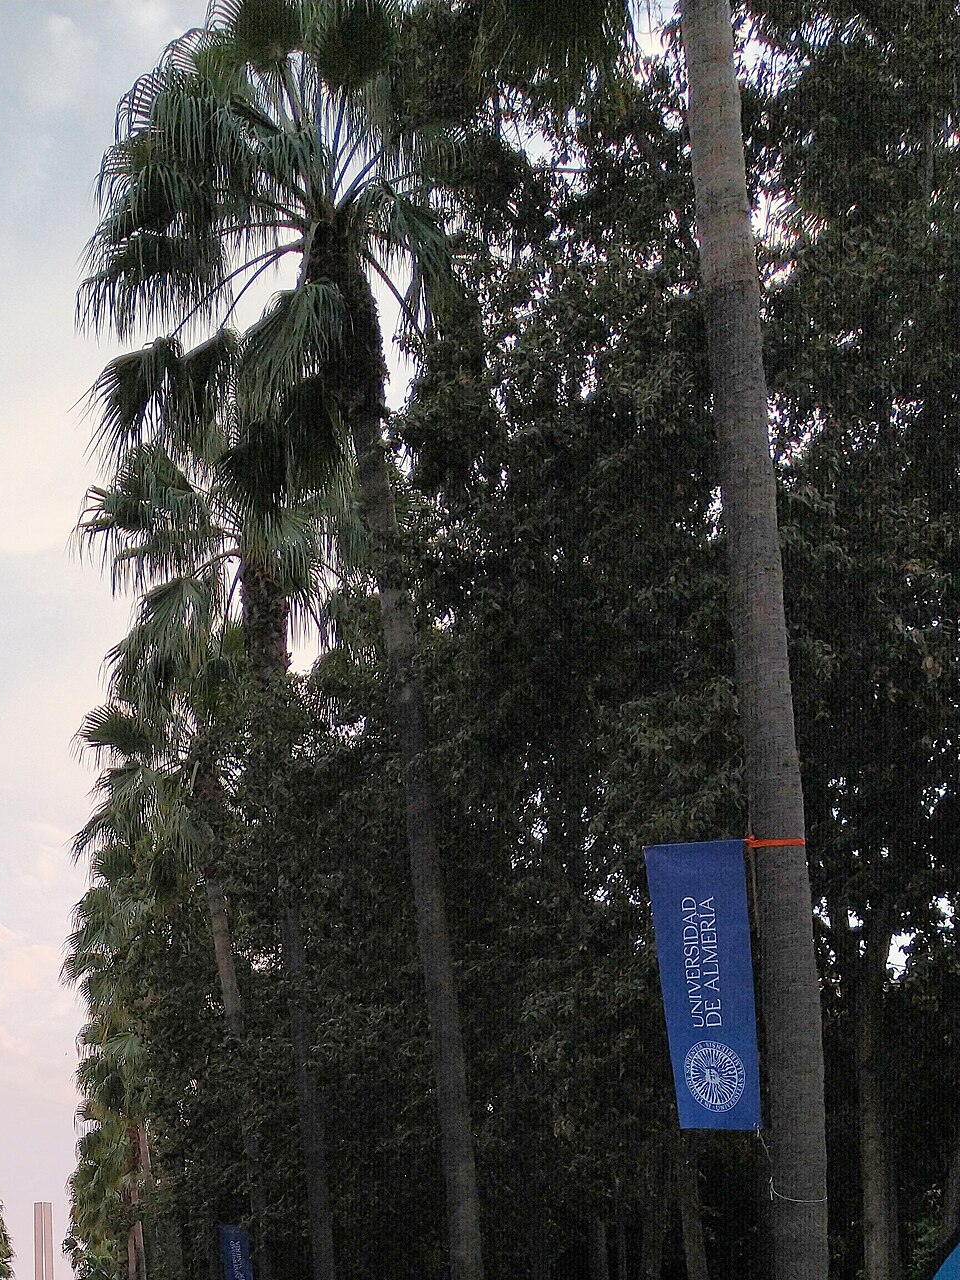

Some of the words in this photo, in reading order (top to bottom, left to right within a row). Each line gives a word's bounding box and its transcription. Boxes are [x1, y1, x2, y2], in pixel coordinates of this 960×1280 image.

[681, 896, 705, 1028] UNIVERSIDAD
[698, 896, 721, 993] ALMERÍA
[705, 998, 722, 1028] DE
